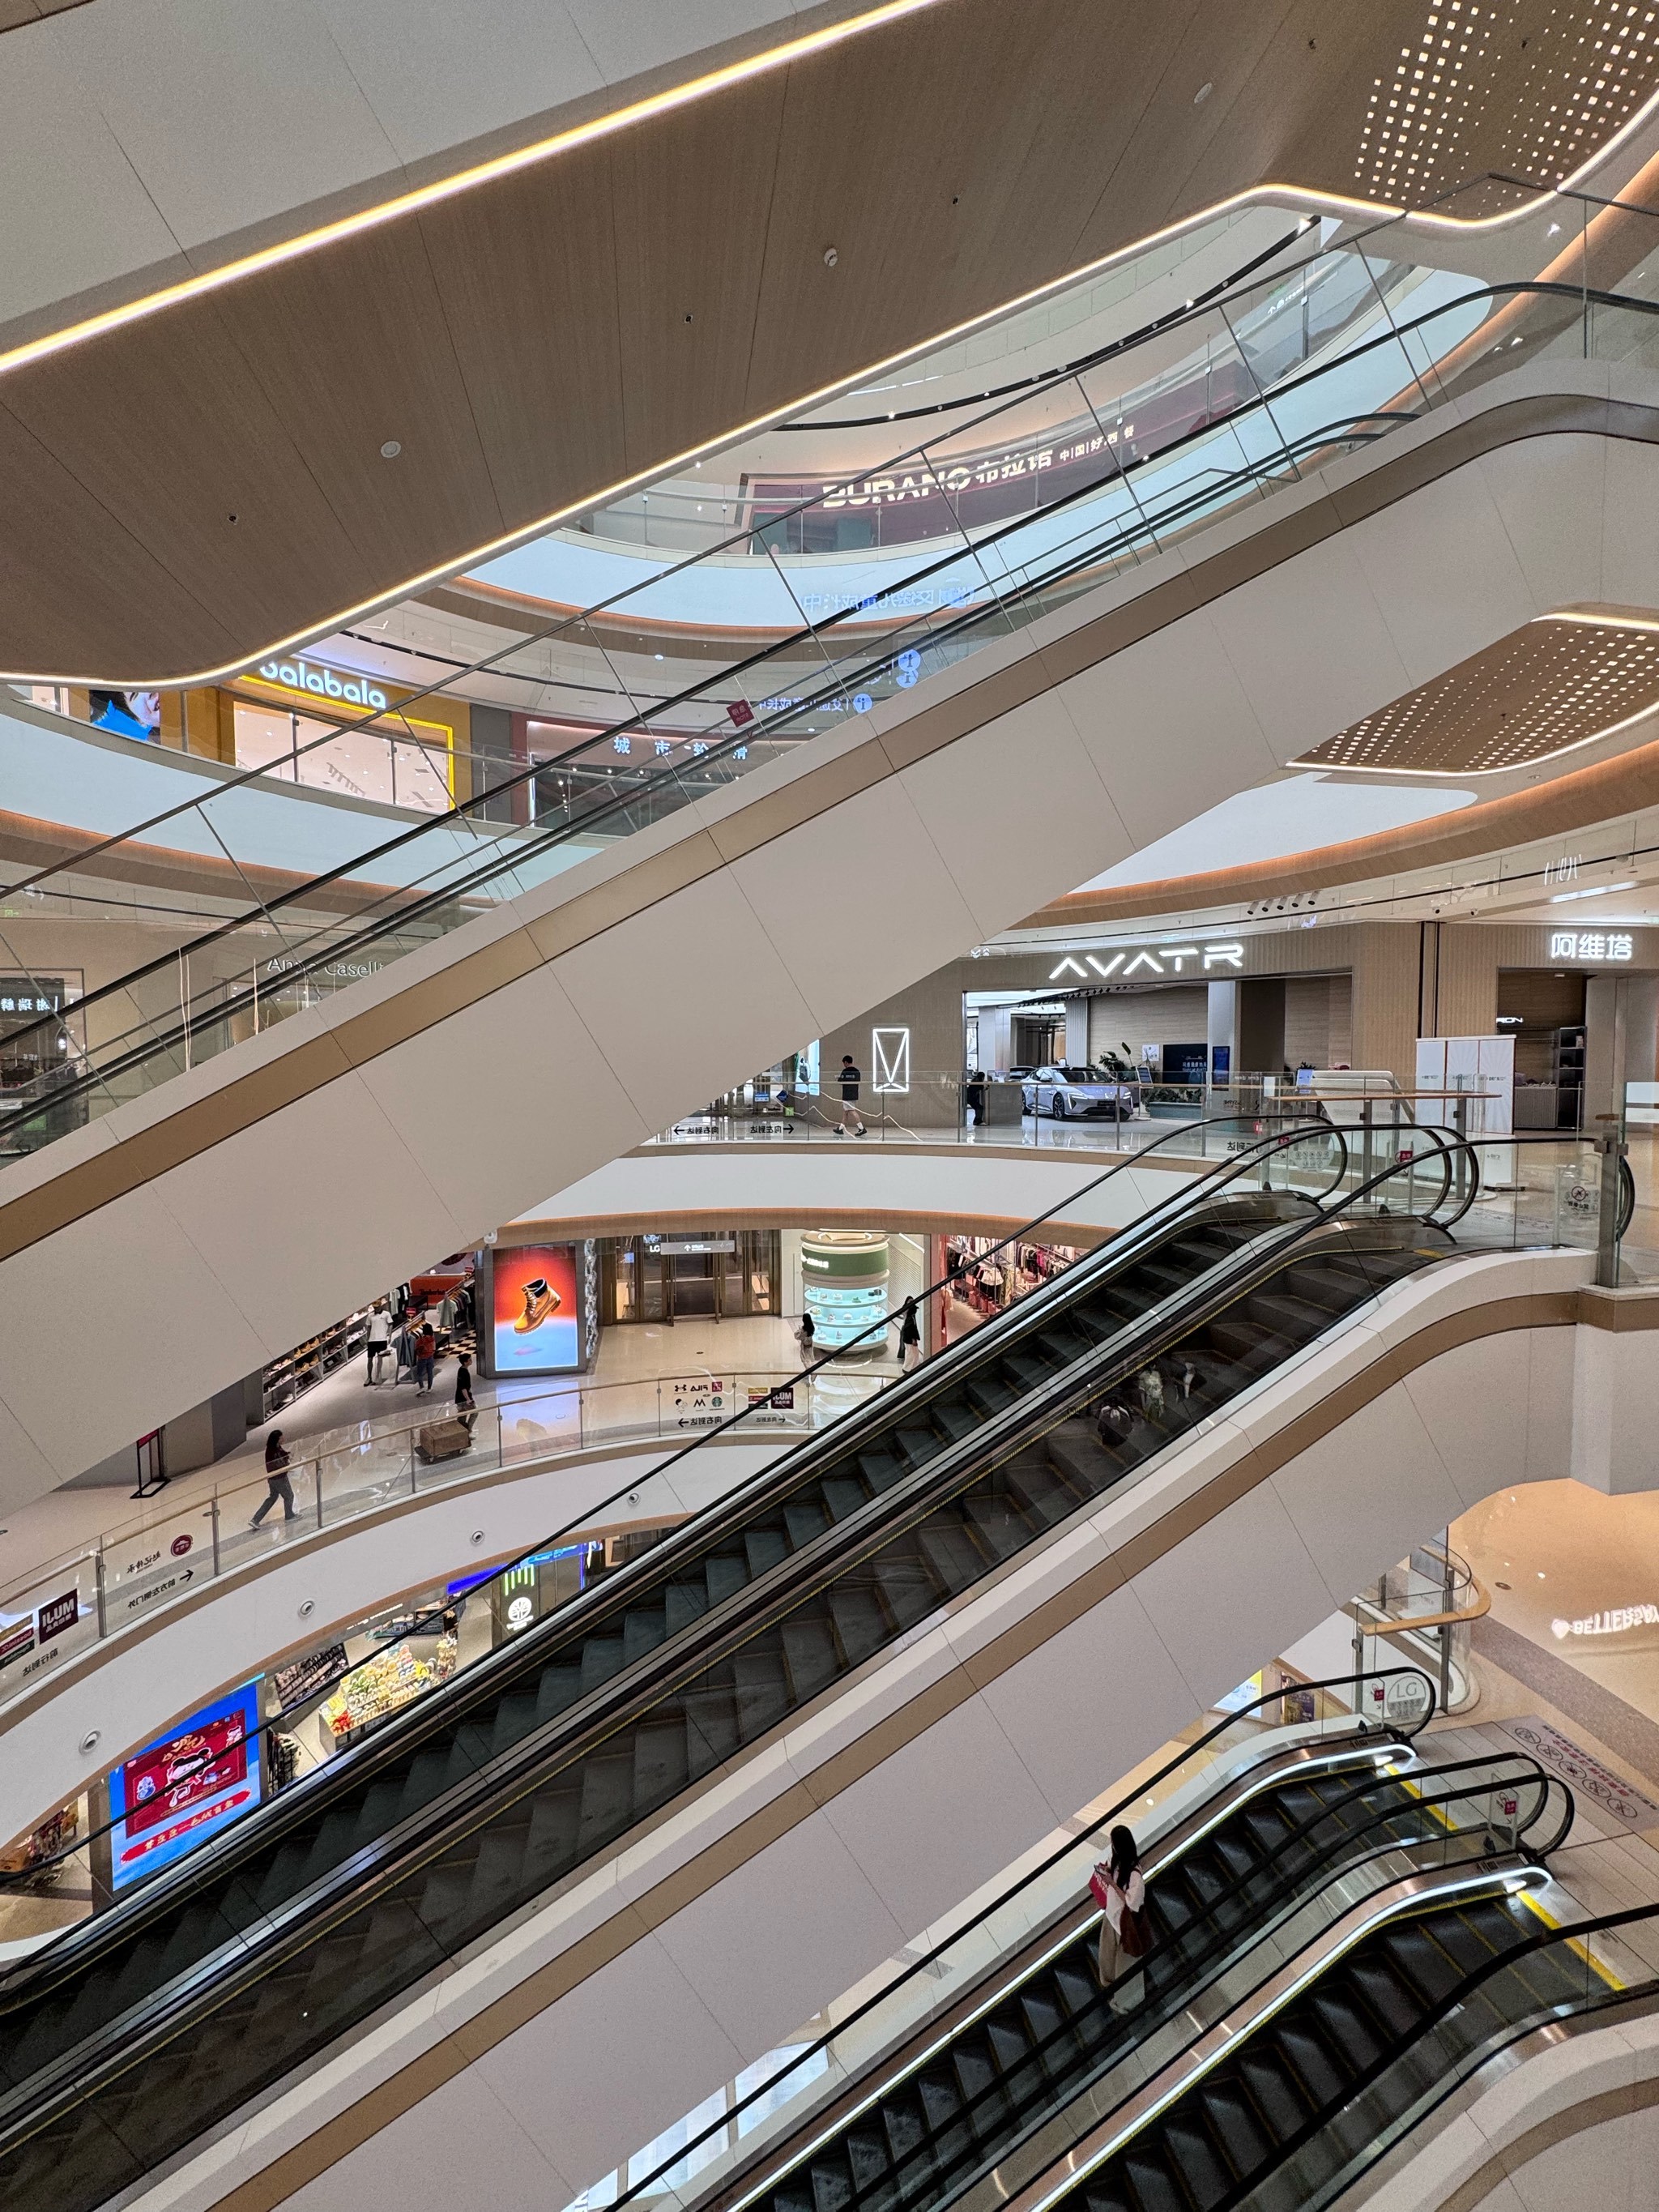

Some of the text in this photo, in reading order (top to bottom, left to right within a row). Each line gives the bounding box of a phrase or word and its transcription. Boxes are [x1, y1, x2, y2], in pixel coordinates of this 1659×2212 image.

[823, 467, 971, 507] BURANO
[1048, 944, 1244, 980] AVATR
[1550, 933, 1633, 961] 阿维塔
